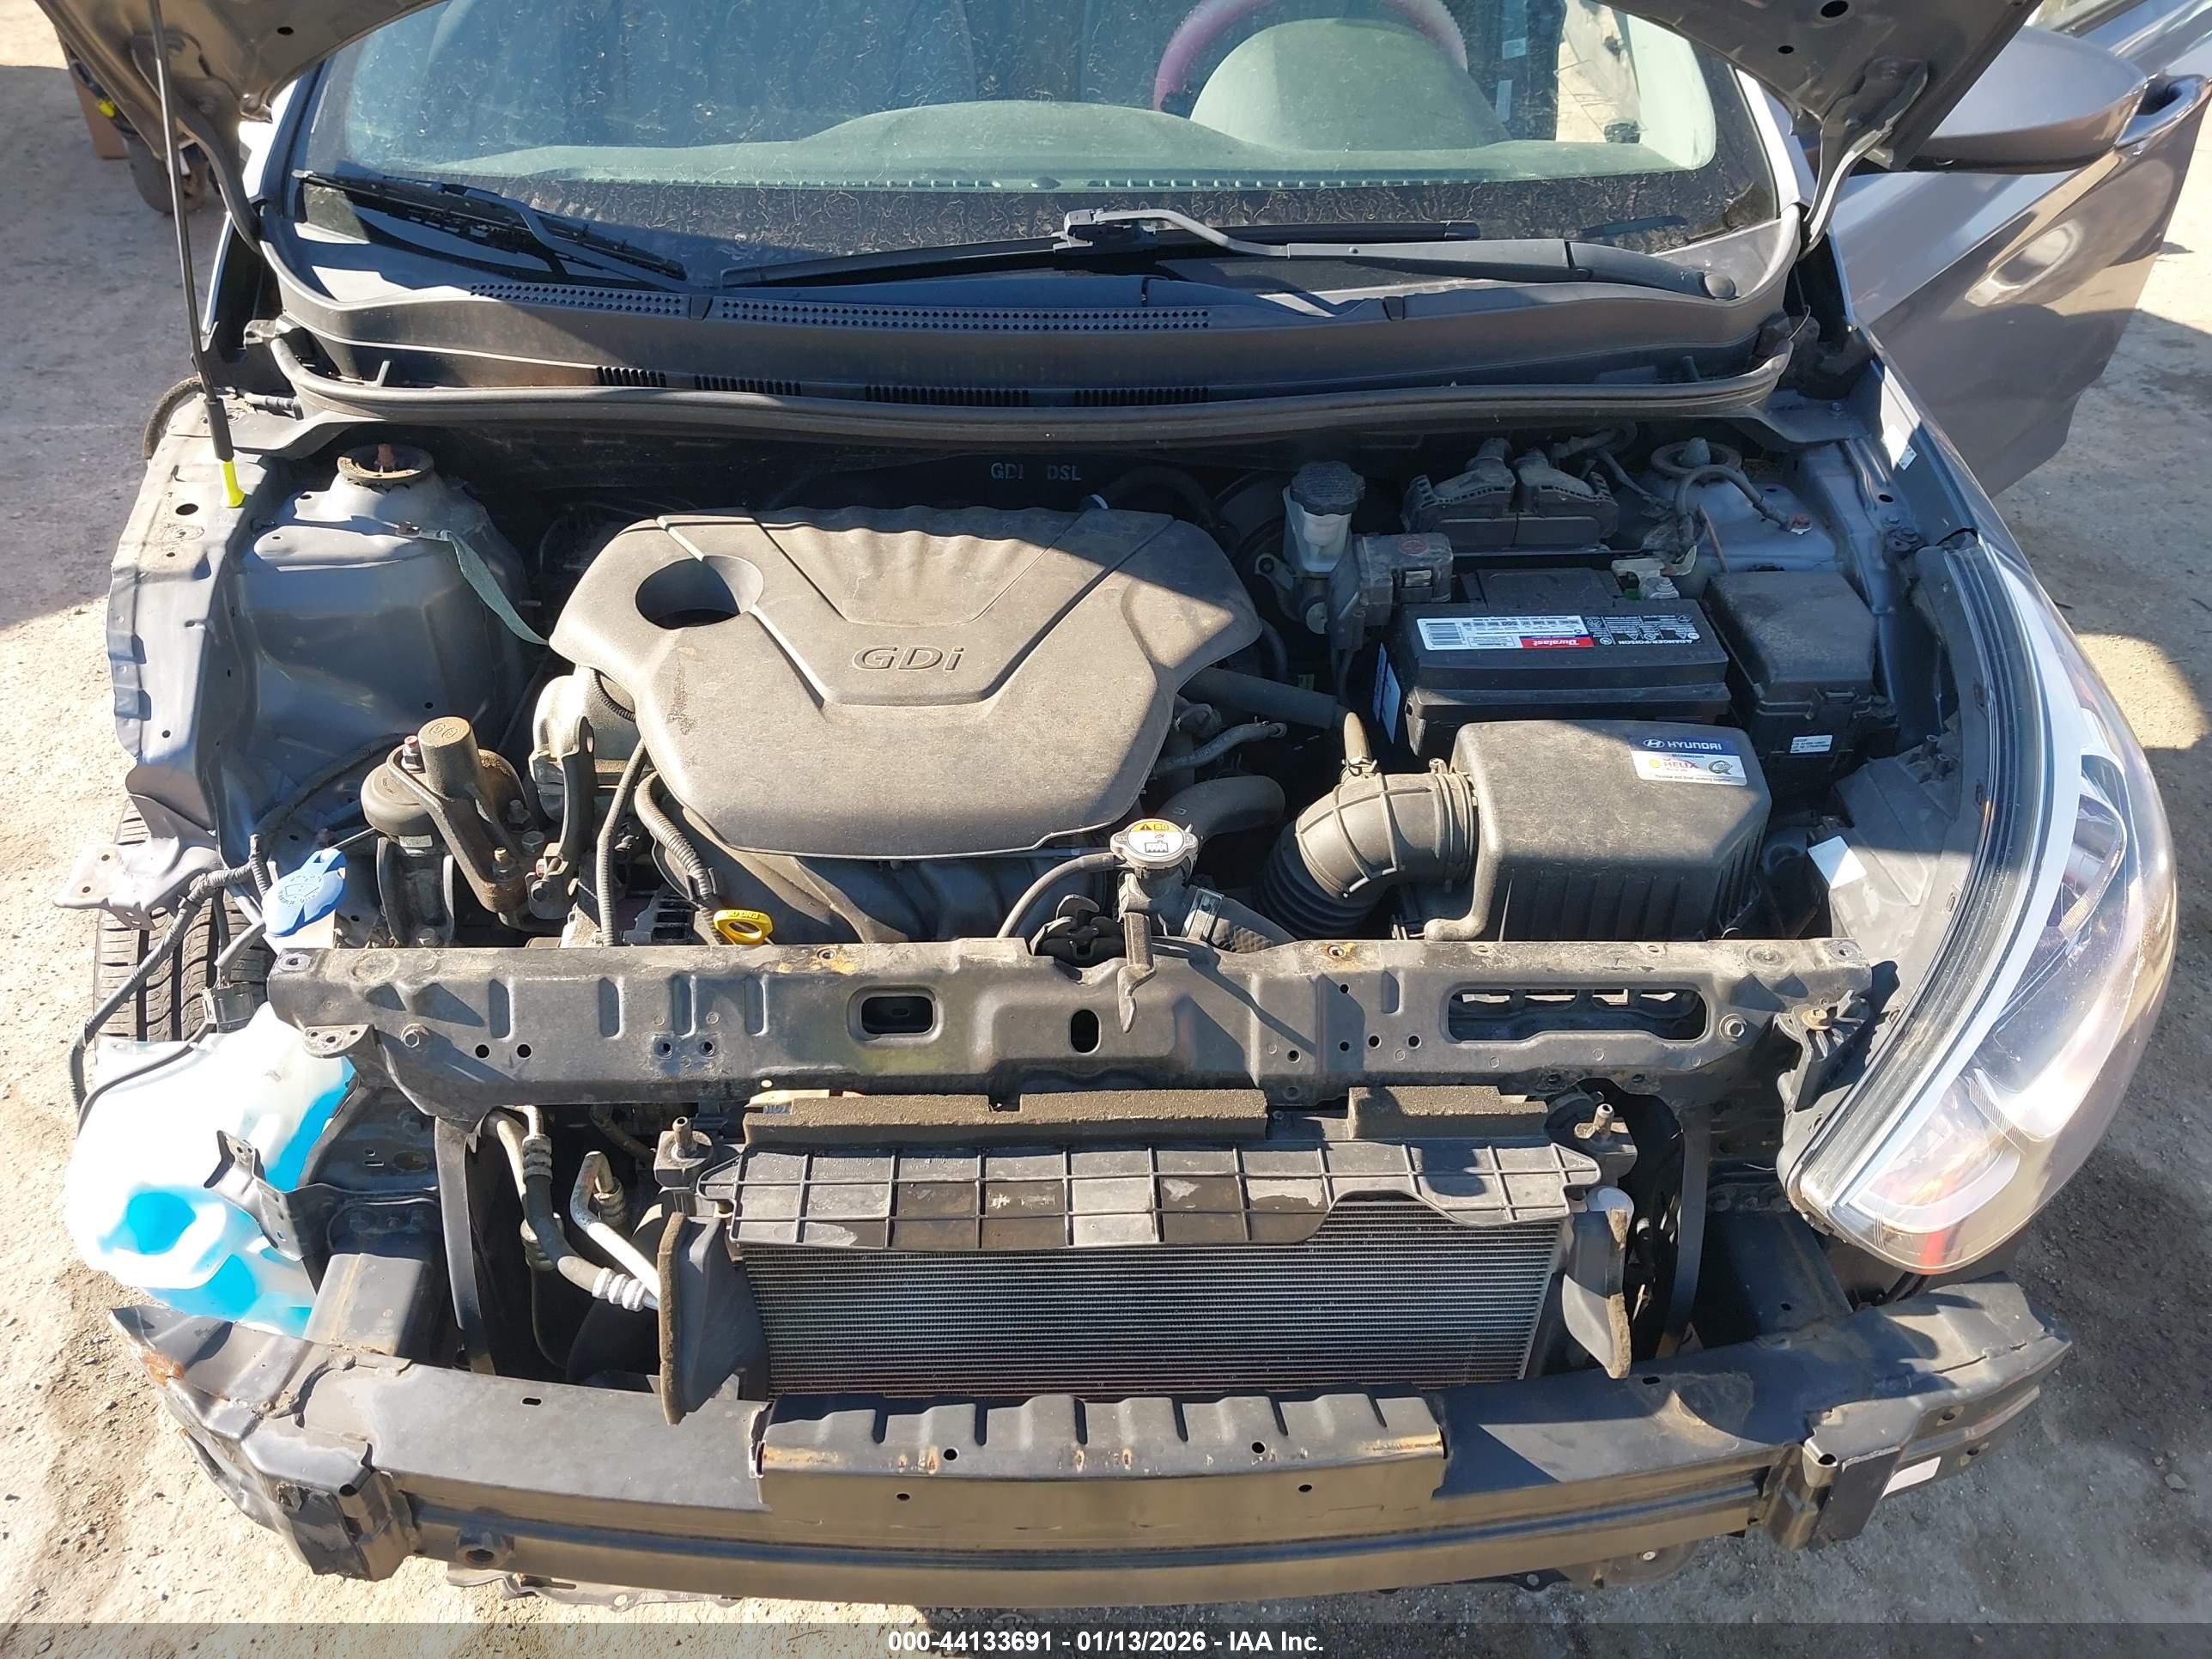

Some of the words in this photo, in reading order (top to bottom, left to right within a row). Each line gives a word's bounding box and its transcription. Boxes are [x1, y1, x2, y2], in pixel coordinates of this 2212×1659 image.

[1047, 465, 1082, 481] DSL
[853, 646, 965, 672] GDi
[1667, 740, 1723, 750] HYUNDAI
